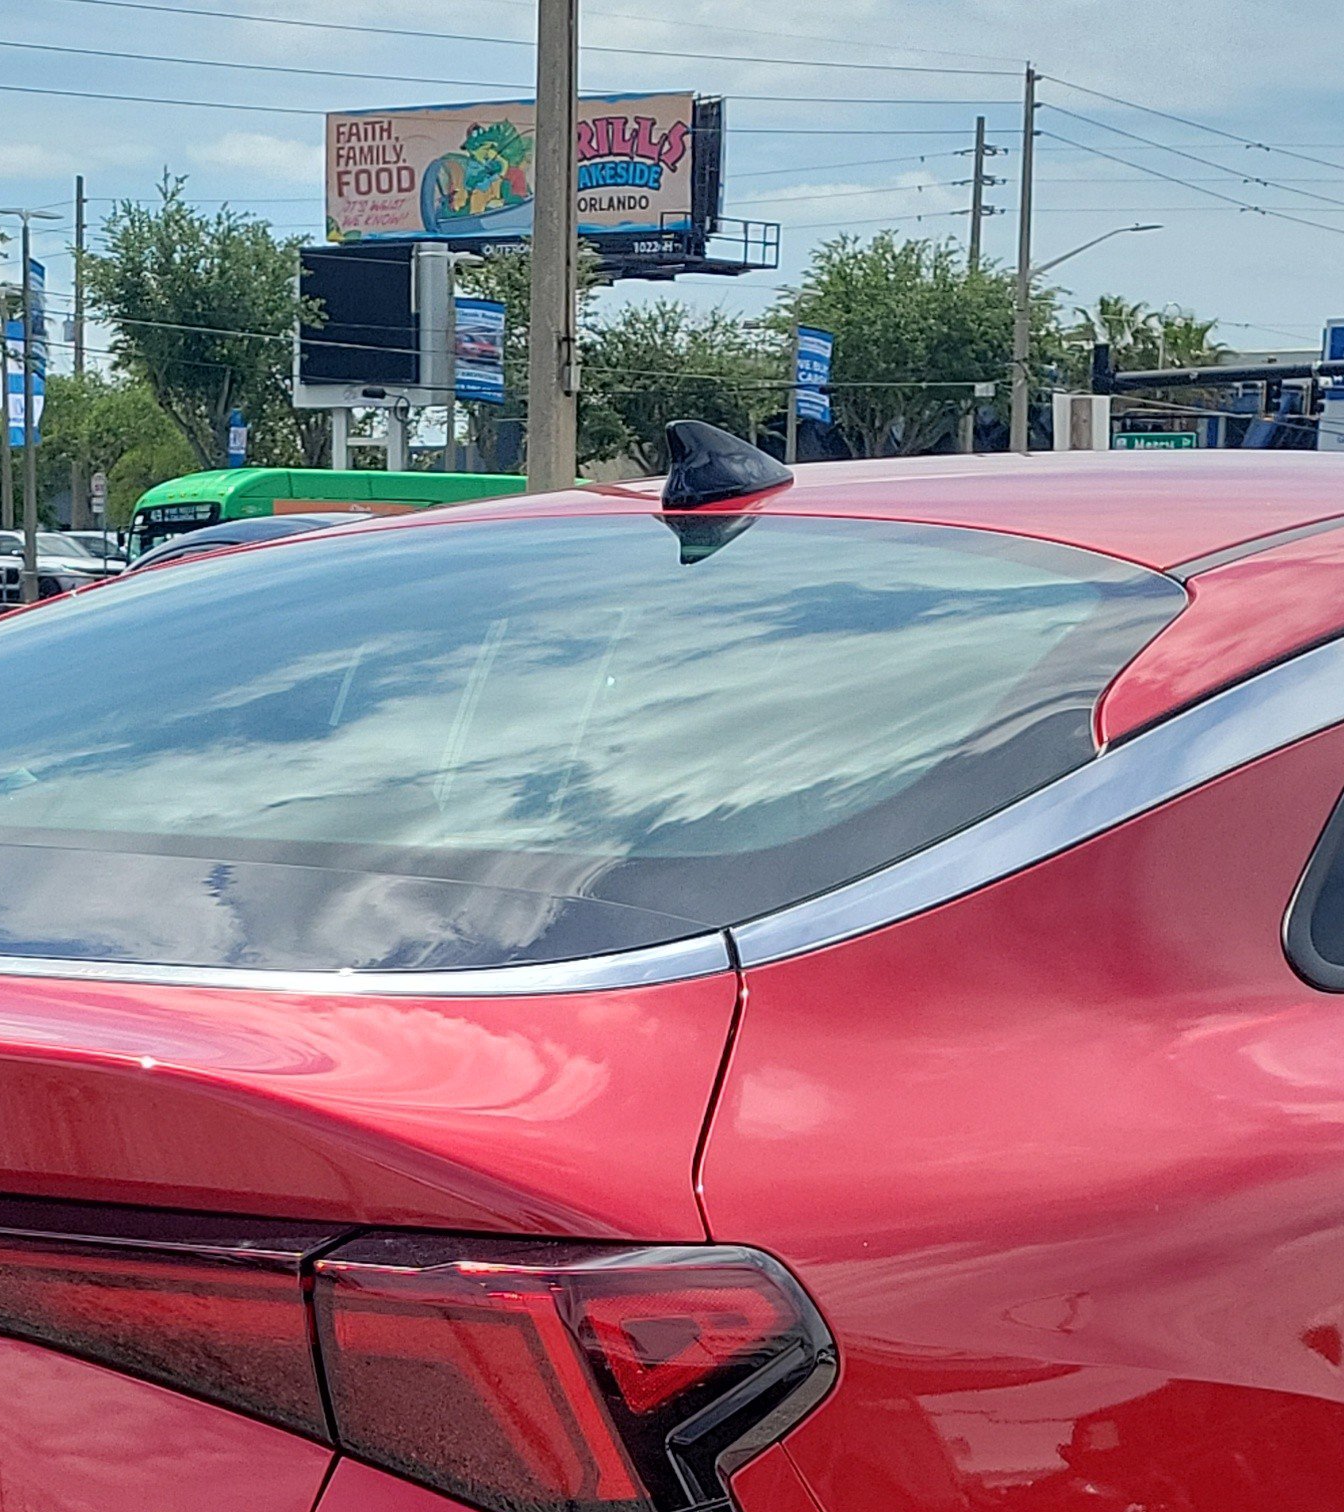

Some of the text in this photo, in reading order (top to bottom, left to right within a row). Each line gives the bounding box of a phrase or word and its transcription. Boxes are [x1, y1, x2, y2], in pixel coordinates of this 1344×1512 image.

[336, 120, 399, 144] FAITH,
[577, 115, 689, 172] RILLS
[336, 165, 416, 198] FOOD
[577, 161, 663, 191] AKESIDE
[577, 195, 650, 212] ORLANDO
